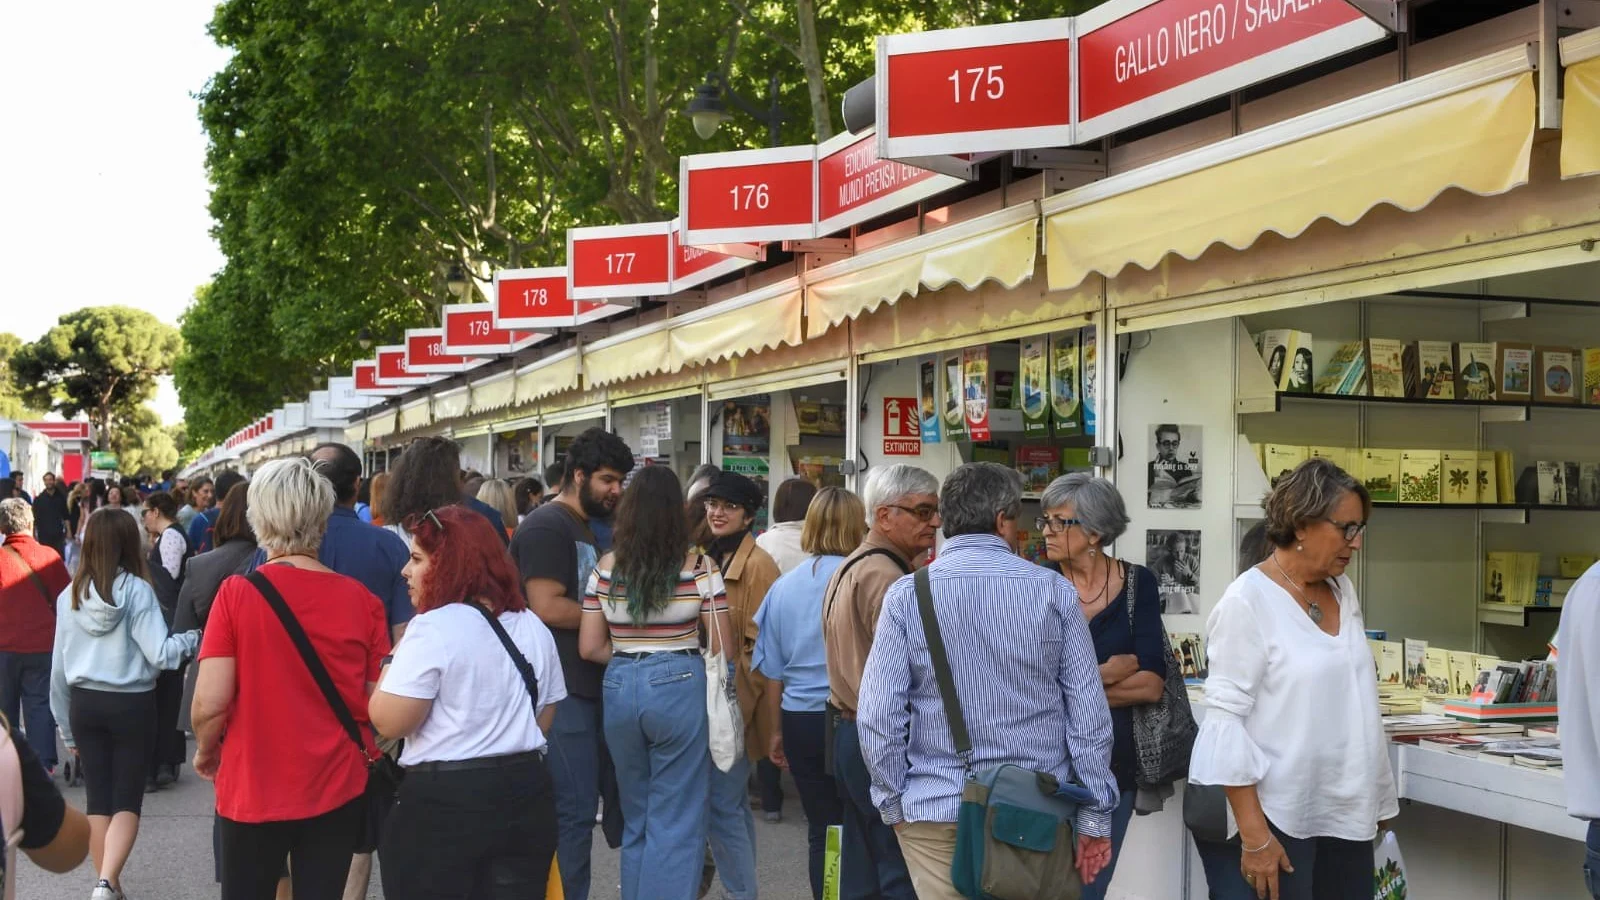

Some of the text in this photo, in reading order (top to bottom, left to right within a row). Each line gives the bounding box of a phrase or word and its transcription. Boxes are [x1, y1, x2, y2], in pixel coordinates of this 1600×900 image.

[1115, 27, 1169, 83] GALLO
[1175, 6, 1226, 60] NERO
[948, 65, 1004, 103] 175
[838, 176, 864, 207] MUNDI
[865, 162, 895, 197] PRENSA
[730, 183, 769, 211] 176
[605, 253, 636, 274] 177
[523, 288, 547, 306] 178
[469, 321, 490, 336] 179
[396, 359, 405, 370] 18
[885, 442, 919, 452] EXTINTOR
